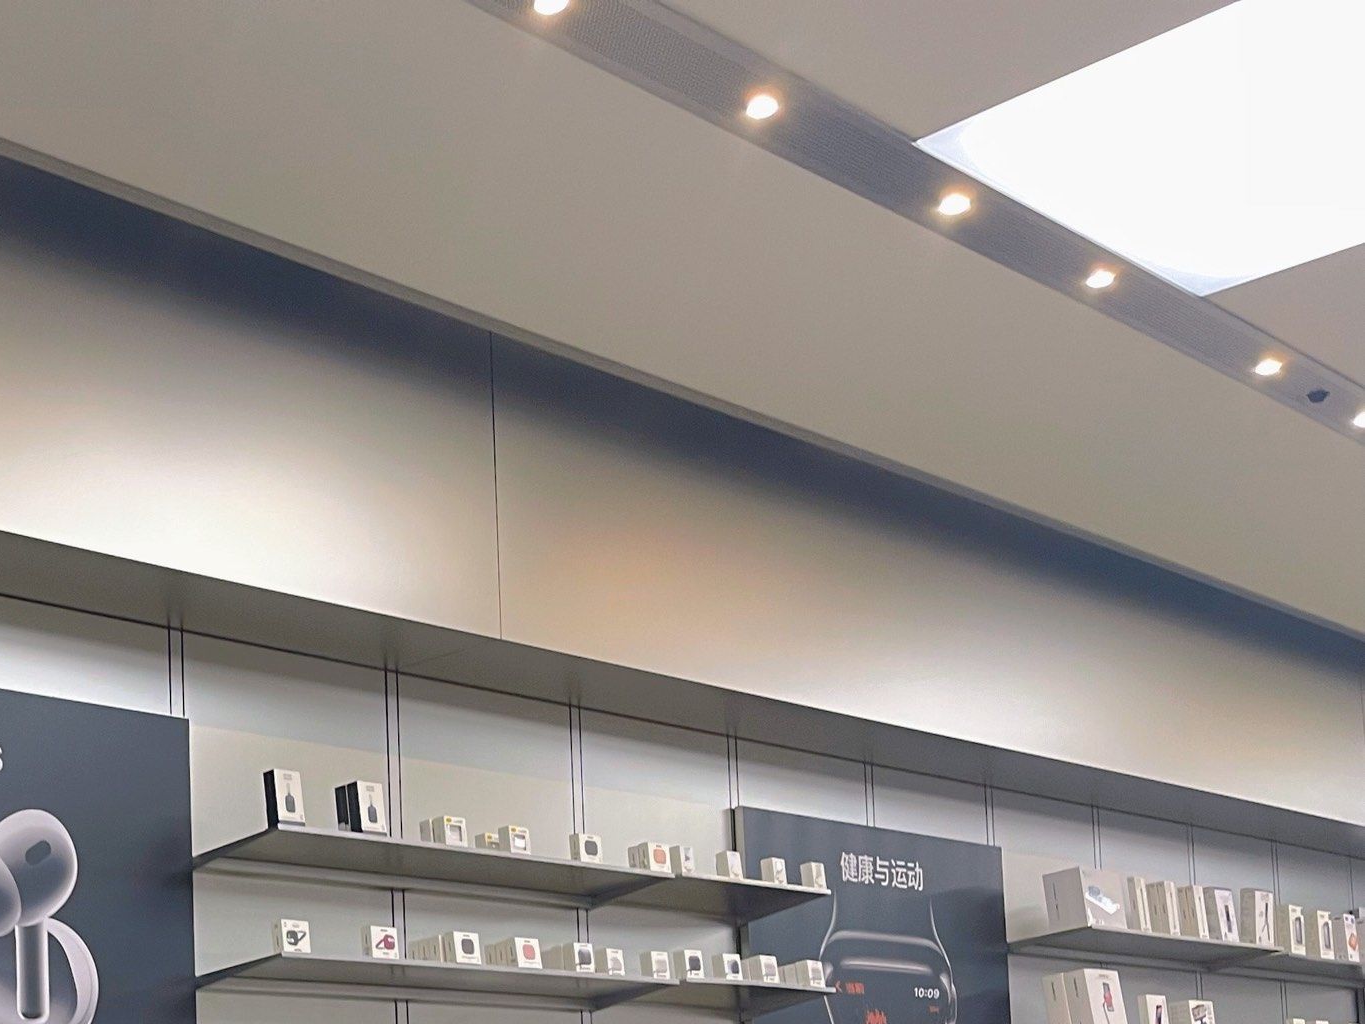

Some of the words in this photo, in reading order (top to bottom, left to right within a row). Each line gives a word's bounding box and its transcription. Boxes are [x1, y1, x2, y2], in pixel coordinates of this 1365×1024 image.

[840, 851, 924, 891] 健康与运动
[914, 987, 940, 999] 10:09
